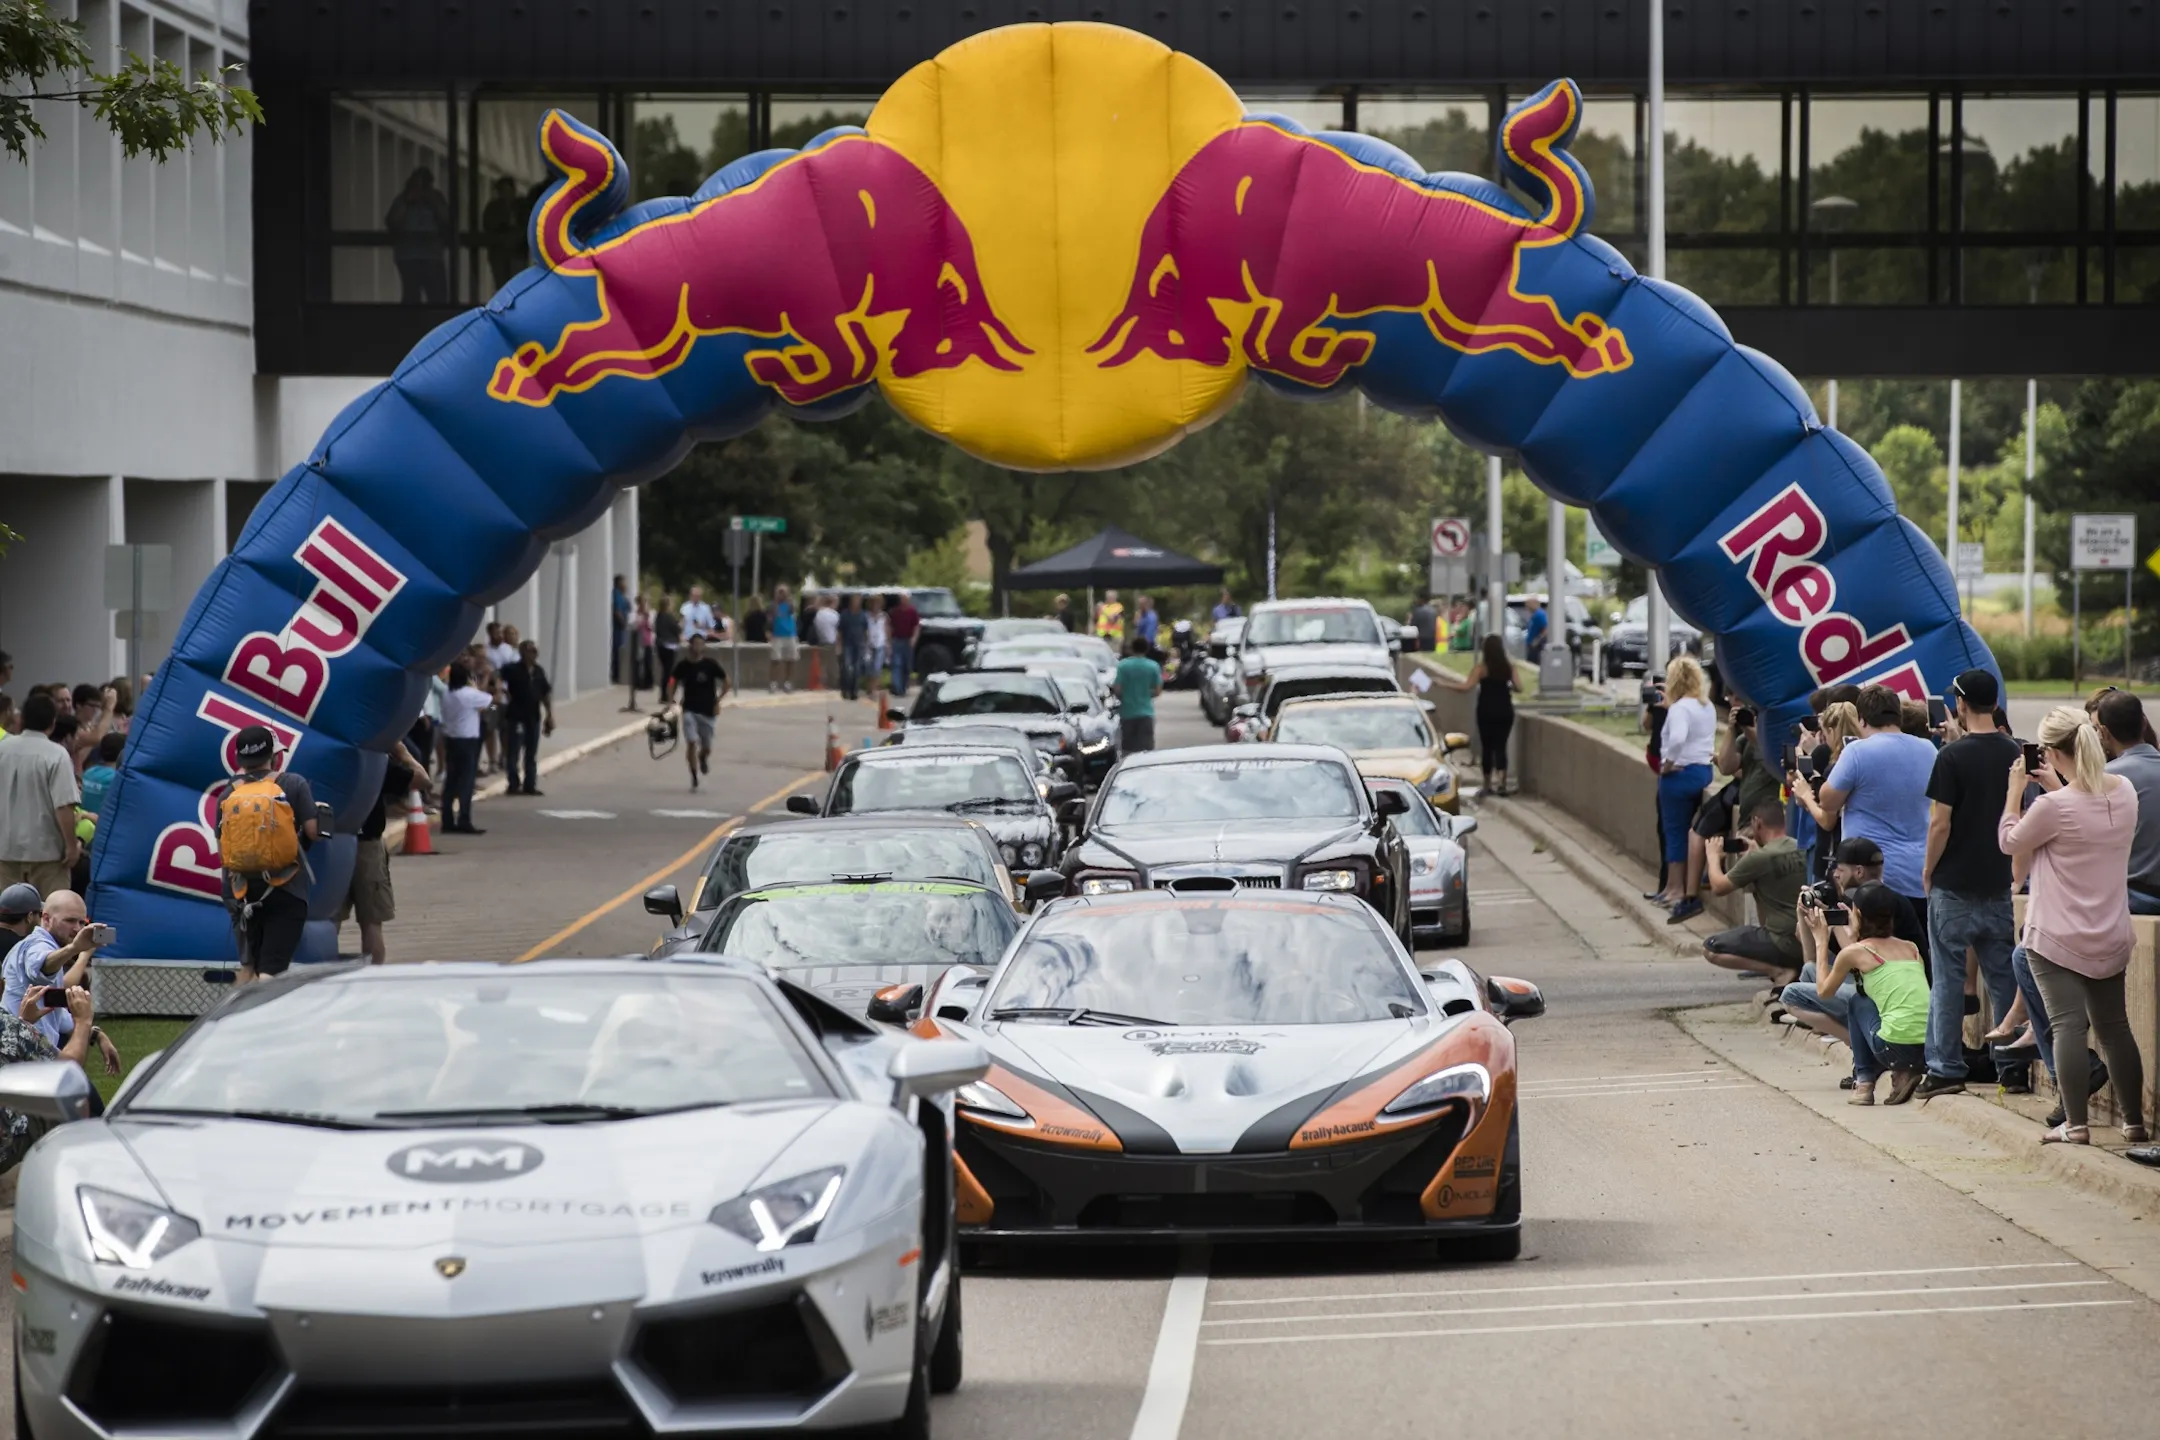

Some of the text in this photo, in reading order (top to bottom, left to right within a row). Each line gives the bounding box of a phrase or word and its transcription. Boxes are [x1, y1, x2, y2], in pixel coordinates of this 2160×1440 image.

[1717, 481, 1914, 689] Red
[222, 515, 409, 725] Bull
[1040, 1123, 1105, 1144] #crownrally
[1302, 1121, 1375, 1142] #rally4acause
[404, 1146, 525, 1174] MM
